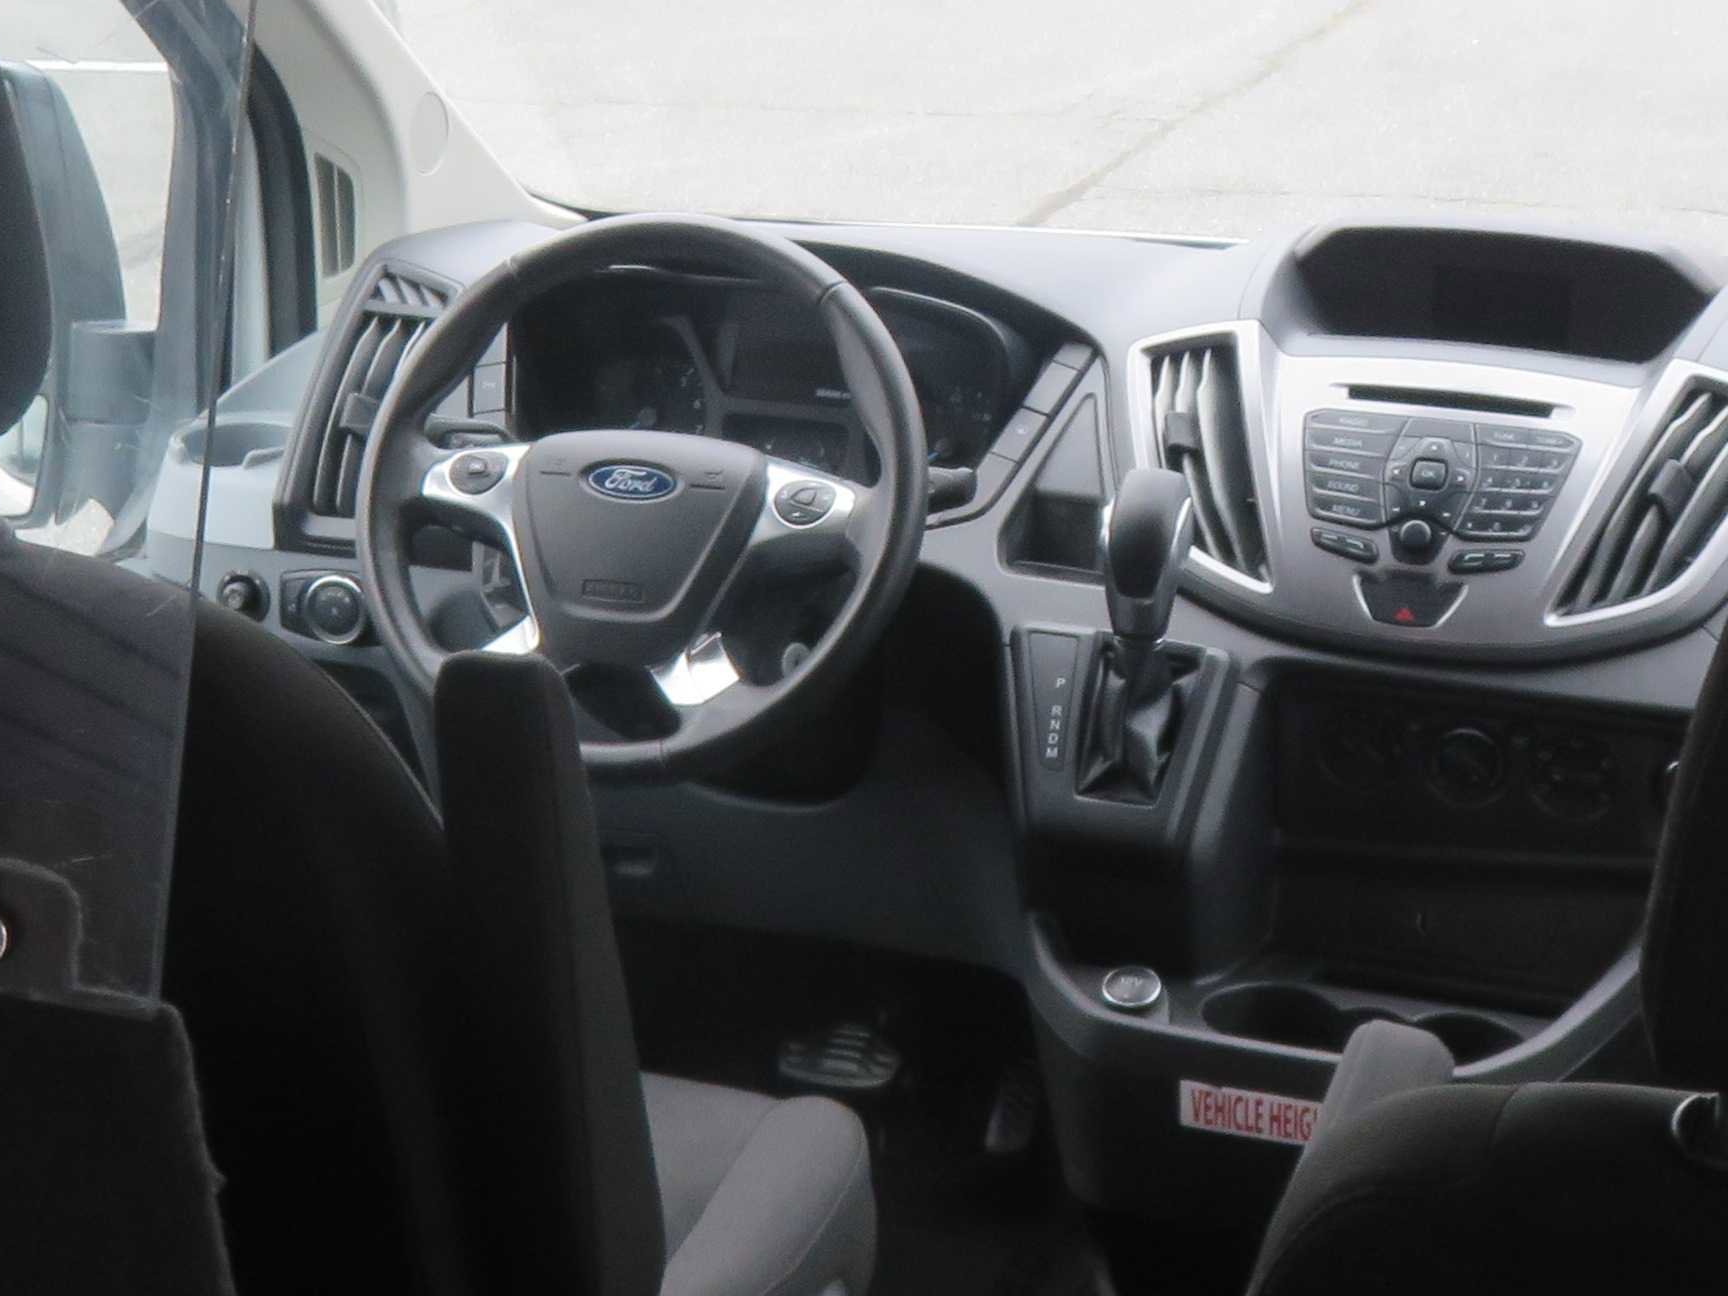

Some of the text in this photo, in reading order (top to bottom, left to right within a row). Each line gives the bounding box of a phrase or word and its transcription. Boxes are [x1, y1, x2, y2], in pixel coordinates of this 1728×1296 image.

[604, 468, 659, 493] Ford
[1191, 1088, 1318, 1141] VEHICLE HEIG
